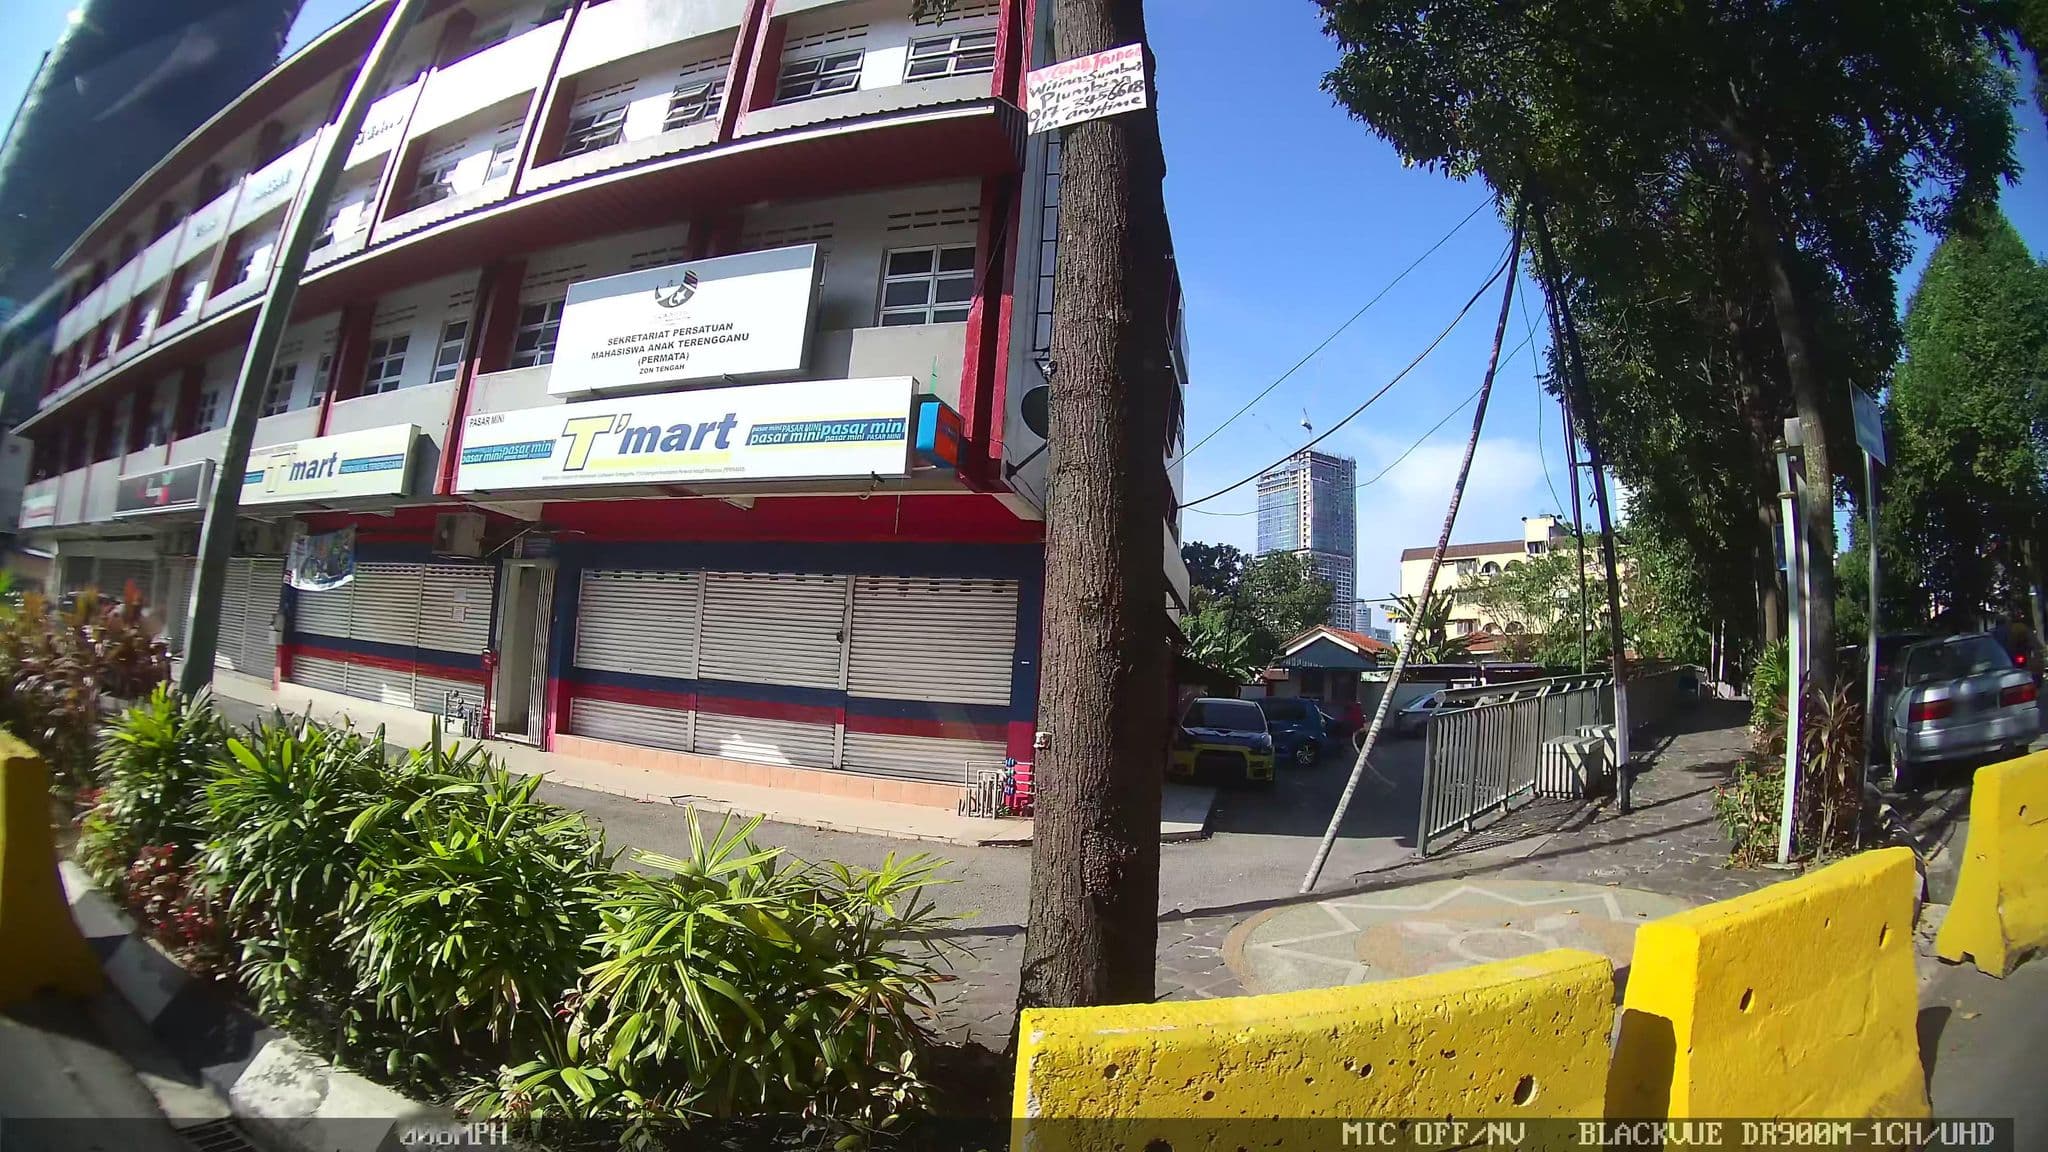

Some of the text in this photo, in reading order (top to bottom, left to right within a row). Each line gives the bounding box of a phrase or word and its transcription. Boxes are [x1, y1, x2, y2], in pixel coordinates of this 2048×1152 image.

[1065, 96, 1143, 121] anytime
[607, 322, 734, 346] SEKRETARIAT PERSATUAN
[591, 332, 750, 360] MAHASISWA ANAK TERENGGANU
[638, 352, 690, 367] (PERMATA)
[639, 364, 685, 375] ZON TENGAH
[469, 416, 491, 428] PASAR
[820, 422, 868, 440] pasar
[561, 412, 738, 472] T'mart
[751, 431, 820, 446] pasar mini
